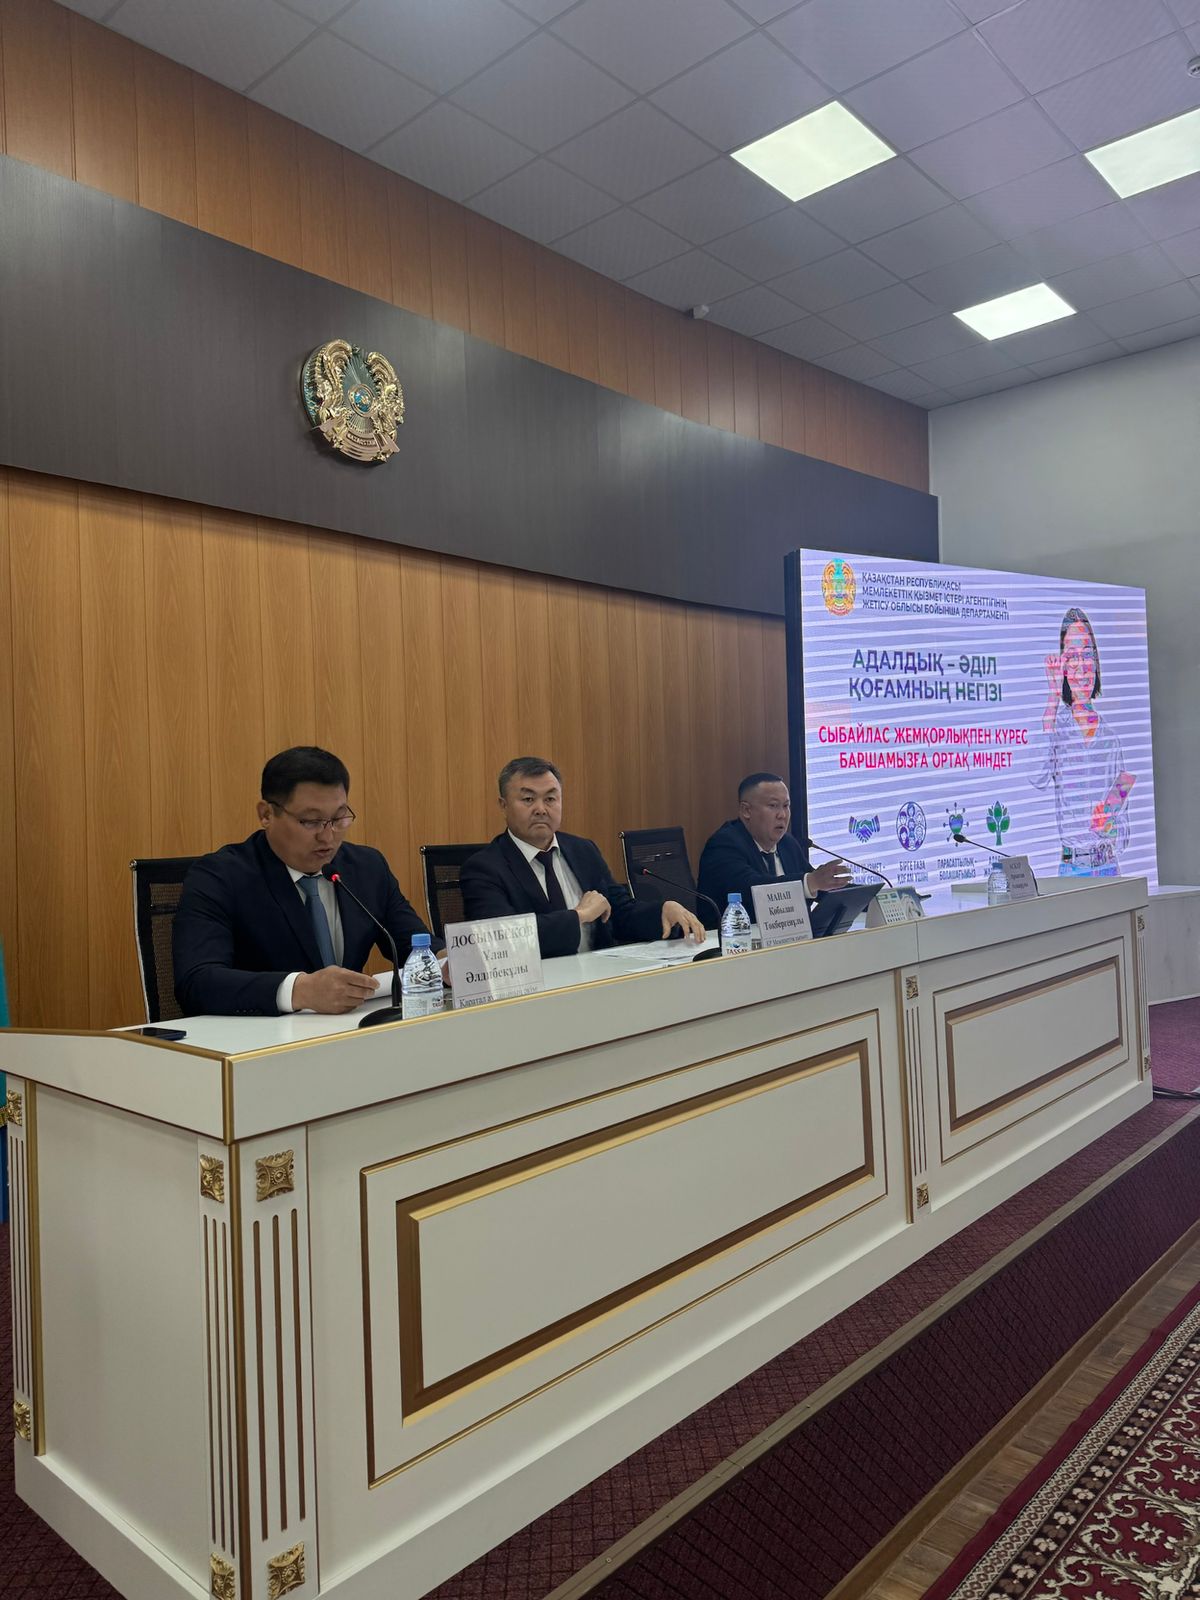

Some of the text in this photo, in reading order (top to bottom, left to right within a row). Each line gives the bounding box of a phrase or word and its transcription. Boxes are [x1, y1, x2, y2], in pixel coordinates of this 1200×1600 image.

[862, 572, 961, 592] ҚАЗАҚСТАН РЕСПУБЛИКАСЫ
[863, 599, 889, 610] ЖЕТІСУ
[890, 602, 923, 613] ОБЛЫСЫ
[853, 649, 944, 676] АДАЛДЫҚ
[959, 655, 997, 677] ӘДІЛ
[849, 677, 1003, 703] ҚОҒАМНЫҢ НЕГІЗІ
[818, 722, 1029, 747] СЫБАЙЛАС ЖЕМҚОРЛЫҚПЕН КҮРЕС
[839, 751, 1013, 771] БАРШАМЫЗҒА ОРТАҚ МІНДЕТ
[451, 925, 534, 949] ДОСЫМБЕКОВ
